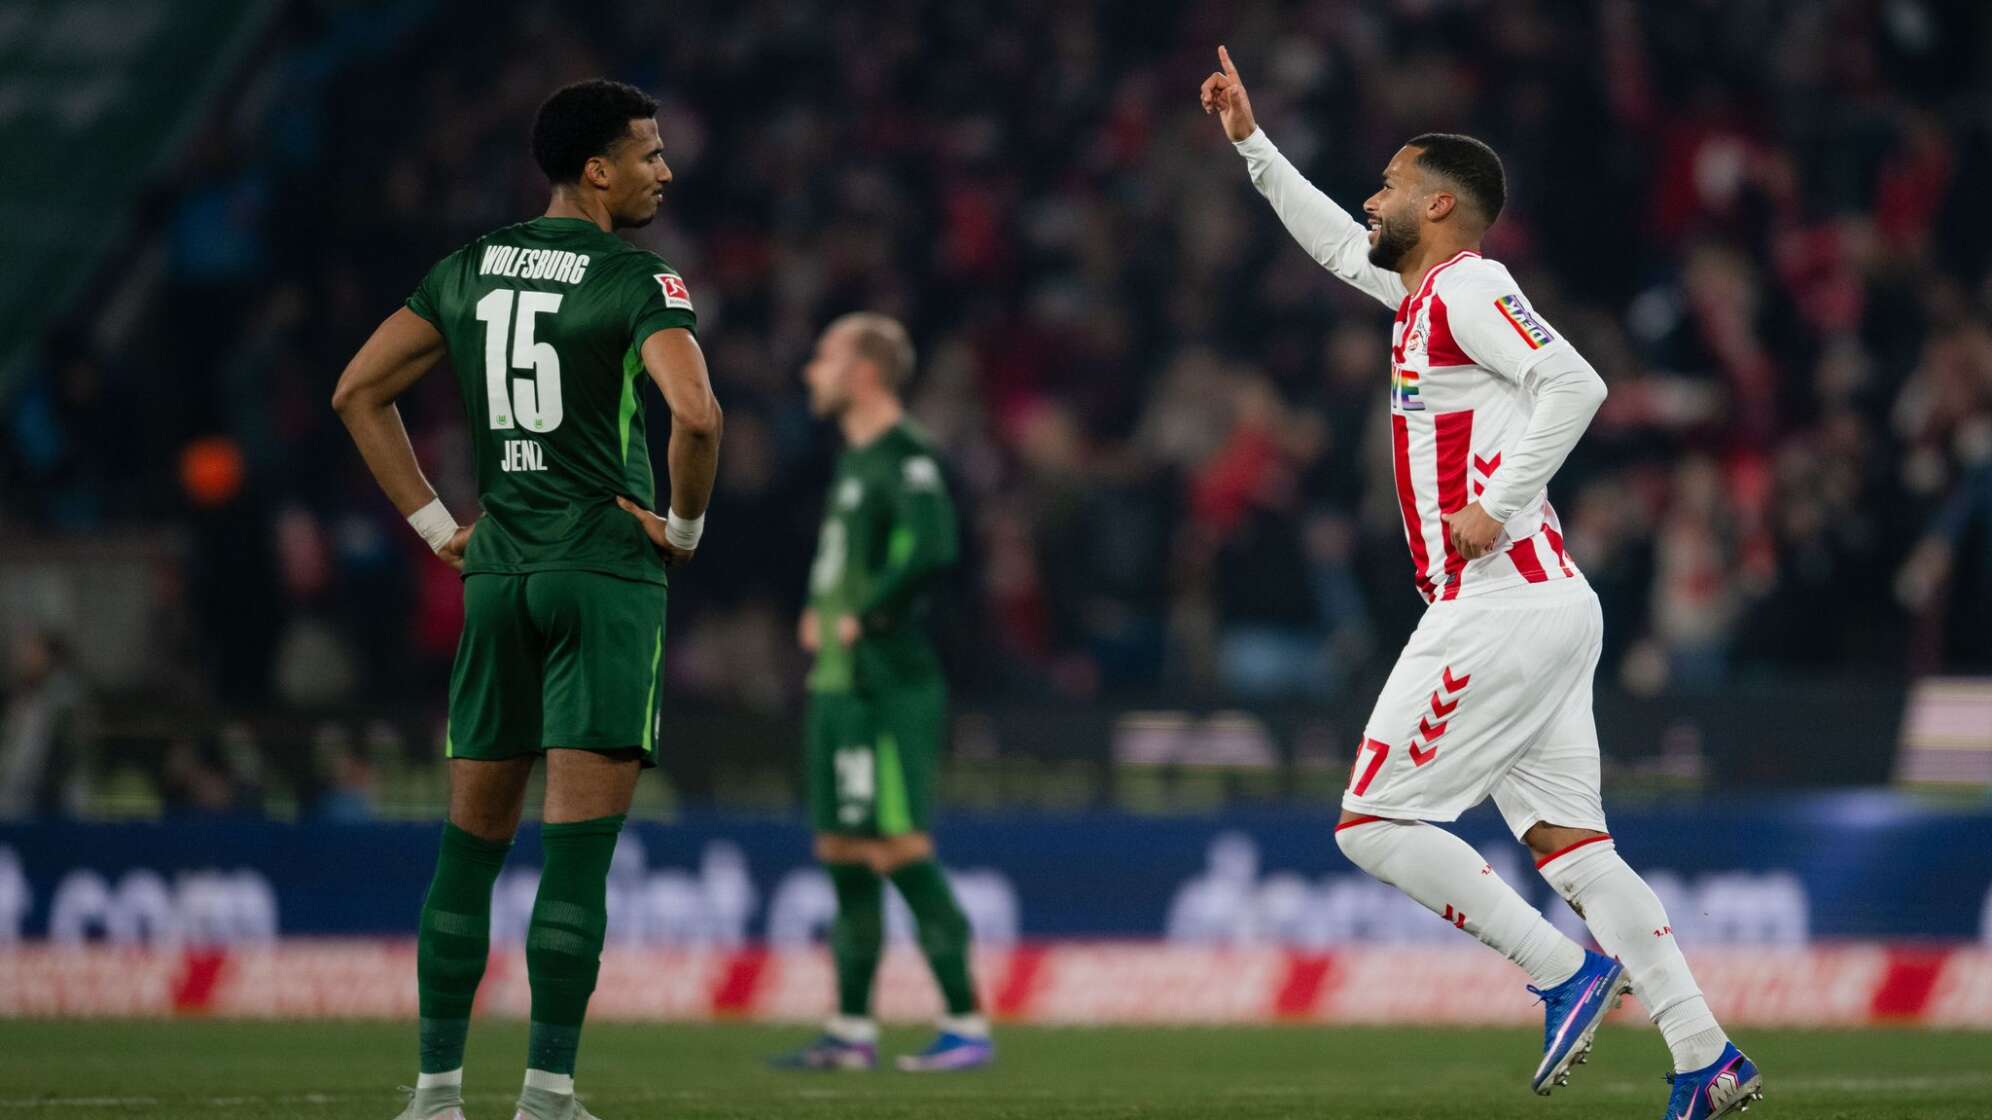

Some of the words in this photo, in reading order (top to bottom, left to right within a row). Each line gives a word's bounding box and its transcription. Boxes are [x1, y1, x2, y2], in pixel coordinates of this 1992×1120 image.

[479, 245, 591, 284] WOLFSBURG
[1502, 299, 1548, 343] DEVK
[475, 288, 564, 433] 15
[1349, 738, 1391, 797] 7
